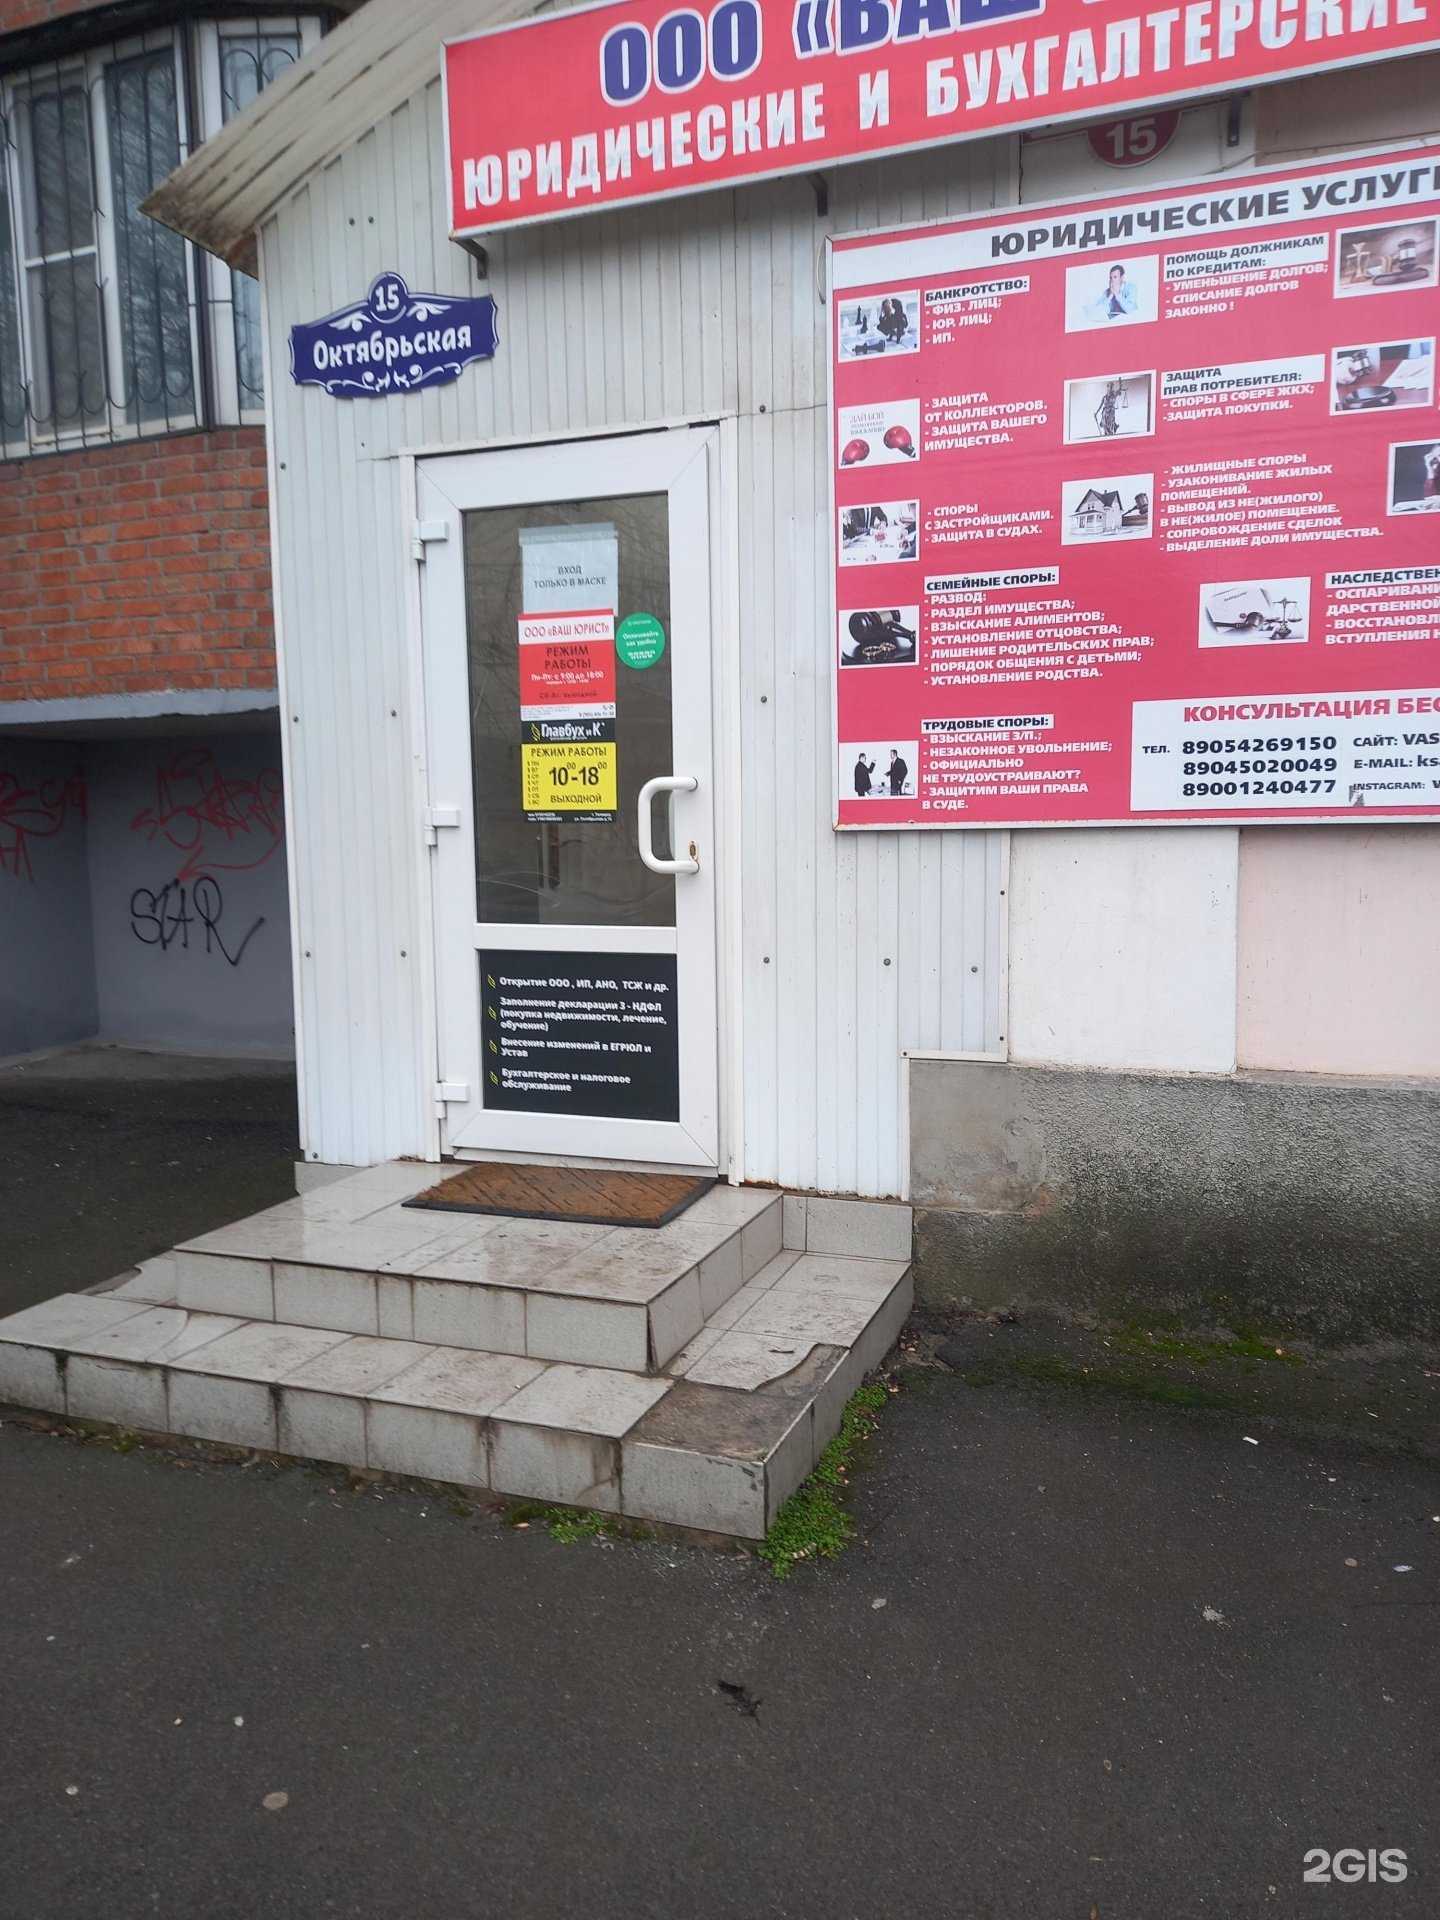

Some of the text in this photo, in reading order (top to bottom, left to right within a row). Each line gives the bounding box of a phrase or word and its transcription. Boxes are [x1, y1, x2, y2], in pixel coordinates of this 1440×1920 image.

[600, 0, 1047, 106] ООО «ВА
[463, 82, 826, 211] ЮРИДИЧЕСКИЕ
[858, 69, 890, 131] И
[1106, 117, 1157, 160] 15
[992, 188, 1289, 258] ЮРИДИЧЕСКИЕ
[1166, 236, 1325, 266] ПОМОЩЬ ДОЛЖНИКАМ
[1166, 258, 1266, 279] ПО КРЕДИТАМ:
[1173, 262, 1329, 291] УМЕНЬШЕНИЕ ДОЛГОВ;
[375, 284, 400, 312] 15
[926, 279, 1028, 302] БАНКРОТСТВО:
[1172, 280, 1300, 305] СПИСАНИЕ ДОЛГОВ
[933, 302, 965, 316] ФИЗ.
[1165, 303, 1227, 319] ЗАКОННО
[932, 332, 955, 344] ИП.
[313, 325, 472, 370] Октябрьская
[1164, 372, 1302, 396] ПРАВ ПОТРЕБИТЕЛЯ:
[1166, 367, 1222, 383] ЗАЩИТА
[931, 393, 988, 408] ЗАЩИТА
[1169, 384, 1315, 409] СПОРЫ В СФЕРЕ ЖКХ;
[925, 400, 1048, 423] ОТ КОЛЛЕКТОРОВ.
[1225, 400, 1293, 416] ПОКУПКИ.
[931, 415, 1048, 438] ЗАЩИТА ВАШЕГО
[925, 434, 1014, 452] ИМУЩЕСТВА.
[1171, 454, 1306, 475] ЖИЛИЩНЫЕ СПОРЫ
[1168, 464, 1332, 489] УЗАКОНИВАНИЕ ЖИЛЫХ
[1161, 484, 1251, 502] ПОМЕЩЕНИЙ.
[934, 504, 978, 517] СПОРЫ
[1167, 491, 1323, 515] ВЫВОД ИЗ НЕ(ЖИЛОГО)
[933, 511, 1054, 530] ЗАСТРОЙЩИКАМИ.
[1160, 504, 1340, 528] В НЕ(ЖИЛОЕ) ПОМЕЩЕНИЕ.
[930, 525, 1042, 544] ЗАЩИТА В СУДАХ.
[1167, 516, 1343, 540] СОПРОВОЖДЕНИЕ СДЕЛОК
[1166, 527, 1384, 552] ВЫДЕЛЕНИЕ ДОЛИ ИМУЩЕСТВА.
[558, 565, 582, 575] ВХОД
[577, 576, 606, 587] МАСКЕ
[926, 572, 1056, 592] СЕМЕЙНЫЕ СПОРЫ:
[931, 599, 1075, 619] РАЗДЕЛ ИМУЩЕСТВА;
[931, 611, 1105, 633] ВЗЫСКАНИЕ АЛИМЕНТОВ;
[931, 625, 1122, 646] УСТАНОВЛЕНИЕ ОТЦОВСТВА;
[1325, 629, 1430, 645] ВСТУПЛЕНИЯ
[546, 645, 589, 657] РЕЖИМ
[931, 636, 1154, 659] ЛИШЕНИЕ РОДИТЕЛЬСКИХ ПРАВ;
[545, 657, 591, 671] РАБОТЫ
[930, 651, 1143, 674] ПОРЯДОК ОБЩЕНИЯ С ДЕТЬМИ;
[931, 668, 1103, 686] УСТАНОВЛЕНИЕ РОДСТВА.
[1184, 698, 1390, 722] КОНСУЛЬТАЦИЯ
[540, 722, 585, 740] Главбух
[923, 716, 1049, 731] ТРУДОВЫЕ СПОРЫ:
[930, 732, 1010, 744] ВЗЫСКАНИЕ
[1142, 736, 1337, 754] ТЕЛ. 89054269150
[1353, 734, 1398, 747] САЙТ:
[531, 746, 607, 758] РЕЖИМ РАБОТЫ
[930, 741, 1112, 757] НЕЗАКОННОЕ УВОЛЬНЕНИЕ;
[930, 758, 1024, 771] ОФИЦИАЛЬНО
[1183, 757, 1337, 775] 89045020049
[1354, 754, 1440, 769] E-MAIL: ks
[923, 769, 1081, 785] НЕ ТРУДОУСТРАИВАЮТ?
[930, 782, 1088, 798] ЗАЩИТИМ ВАШИ ПРАВА
[1182, 779, 1337, 796] 89001240477
[1353, 782, 1426, 791] INSTAGRAM:
[550, 793, 602, 804] ВЫХОДНОЙ
[922, 799, 968, 811] В СУДЕ.
[500, 976, 547, 988] Открытие
[595, 979, 618, 991] АНО,
[623, 980, 643, 991] ТСЖ
[653, 981, 669, 992] др.
[500, 997, 662, 1013] Заполнение декларации НДФЛ
[500, 1010, 667, 1025] (покупка недвижимости, лечение,
[500, 1020, 549, 1032] обучение)
[501, 1037, 545, 1048] Внесение
[546, 1040, 601, 1051] изменений
[610, 1042, 642, 1053] ЕГРЮЛ
[501, 1048, 529, 1059] Устав
[501, 1067, 570, 1081] Бухгалтерское
[580, 1073, 631, 1084] налоговое
[501, 1079, 572, 1092] обслуживание
